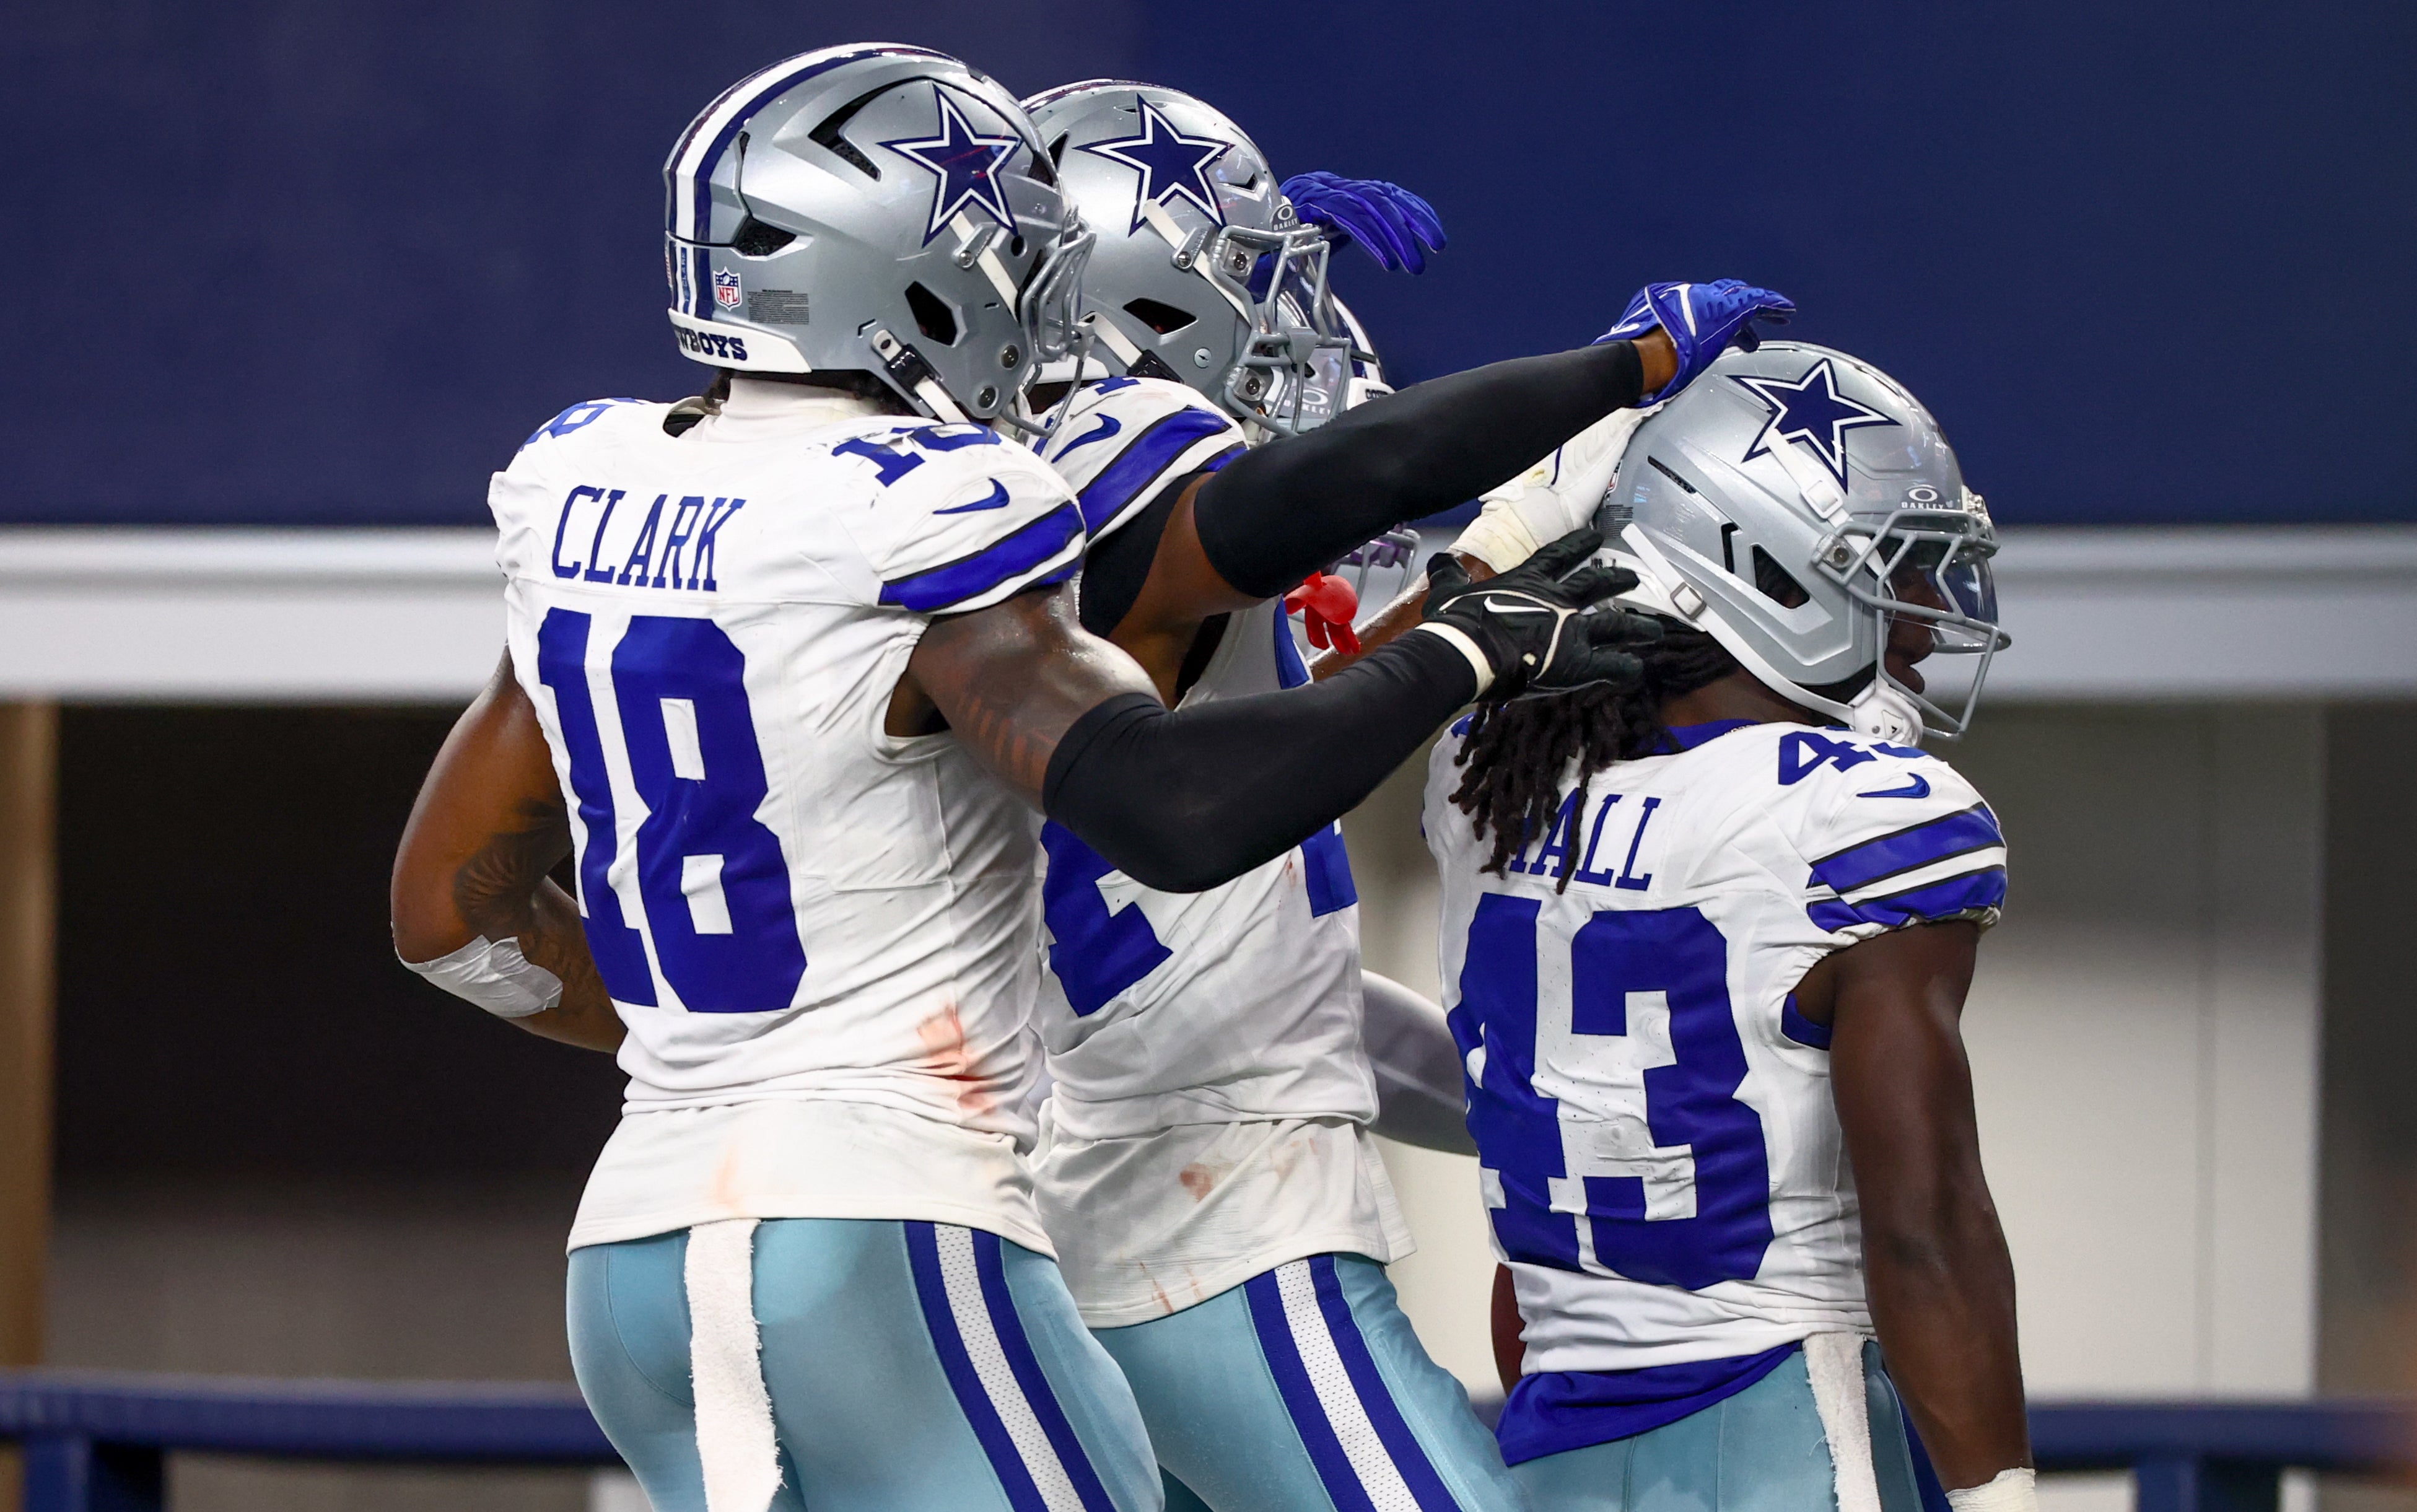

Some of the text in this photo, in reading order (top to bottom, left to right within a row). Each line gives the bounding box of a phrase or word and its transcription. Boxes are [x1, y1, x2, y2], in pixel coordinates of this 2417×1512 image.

[1274, 218, 1298, 231] OAKLEY
[719, 287, 738, 304] NFL
[674, 325, 747, 361] WBOYS
[553, 485, 746, 592] CLARK
[538, 607, 807, 1013] 18
[1448, 893, 1774, 1291] 43
